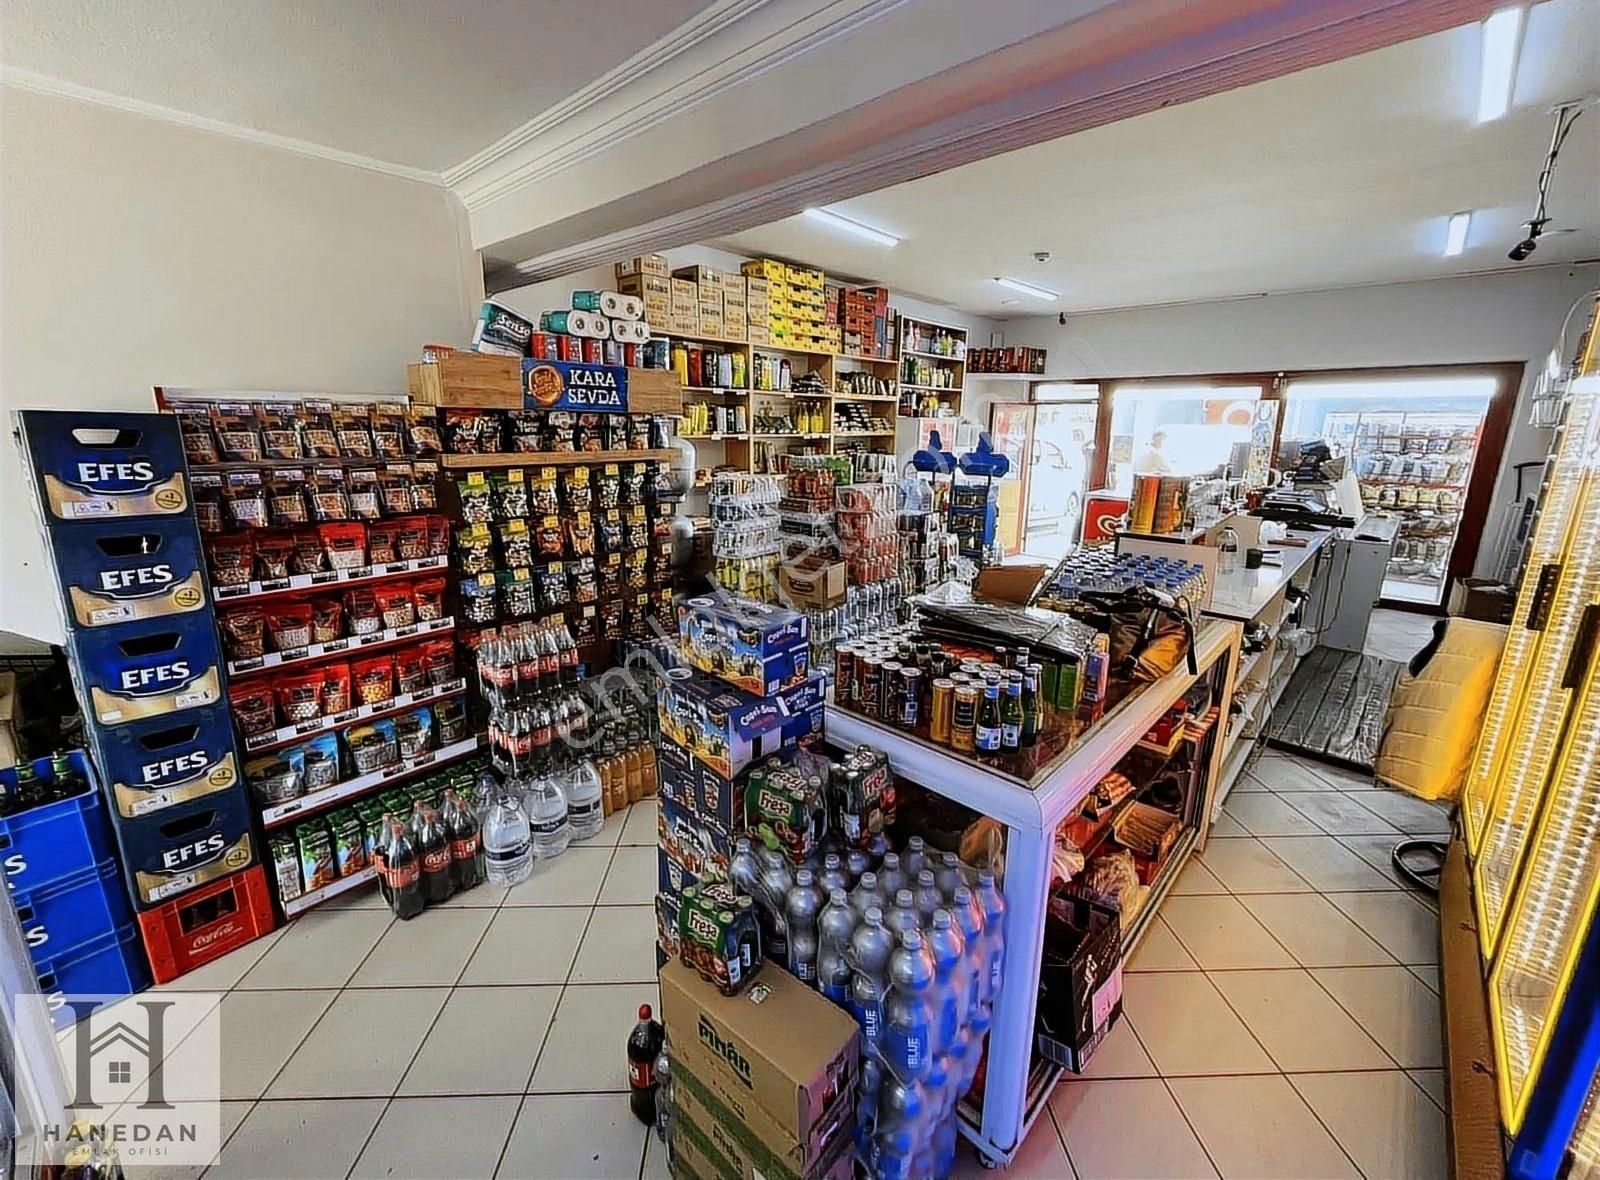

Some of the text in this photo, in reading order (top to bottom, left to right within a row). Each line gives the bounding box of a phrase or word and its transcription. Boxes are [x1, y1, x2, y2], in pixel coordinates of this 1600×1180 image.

[498, 312, 532, 337] Senso
[569, 369, 617, 387] KARA
[567, 388, 621, 405] SEVDA
[78, 462, 154, 483] EFES
[101, 564, 172, 590] EFES
[121, 661, 190, 689] EFES
[142, 750, 208, 783] EFES
[163, 834, 224, 868] EFES
[866, 1010, 877, 1037] BLUE
[907, 1037, 920, 1069] BLUE
